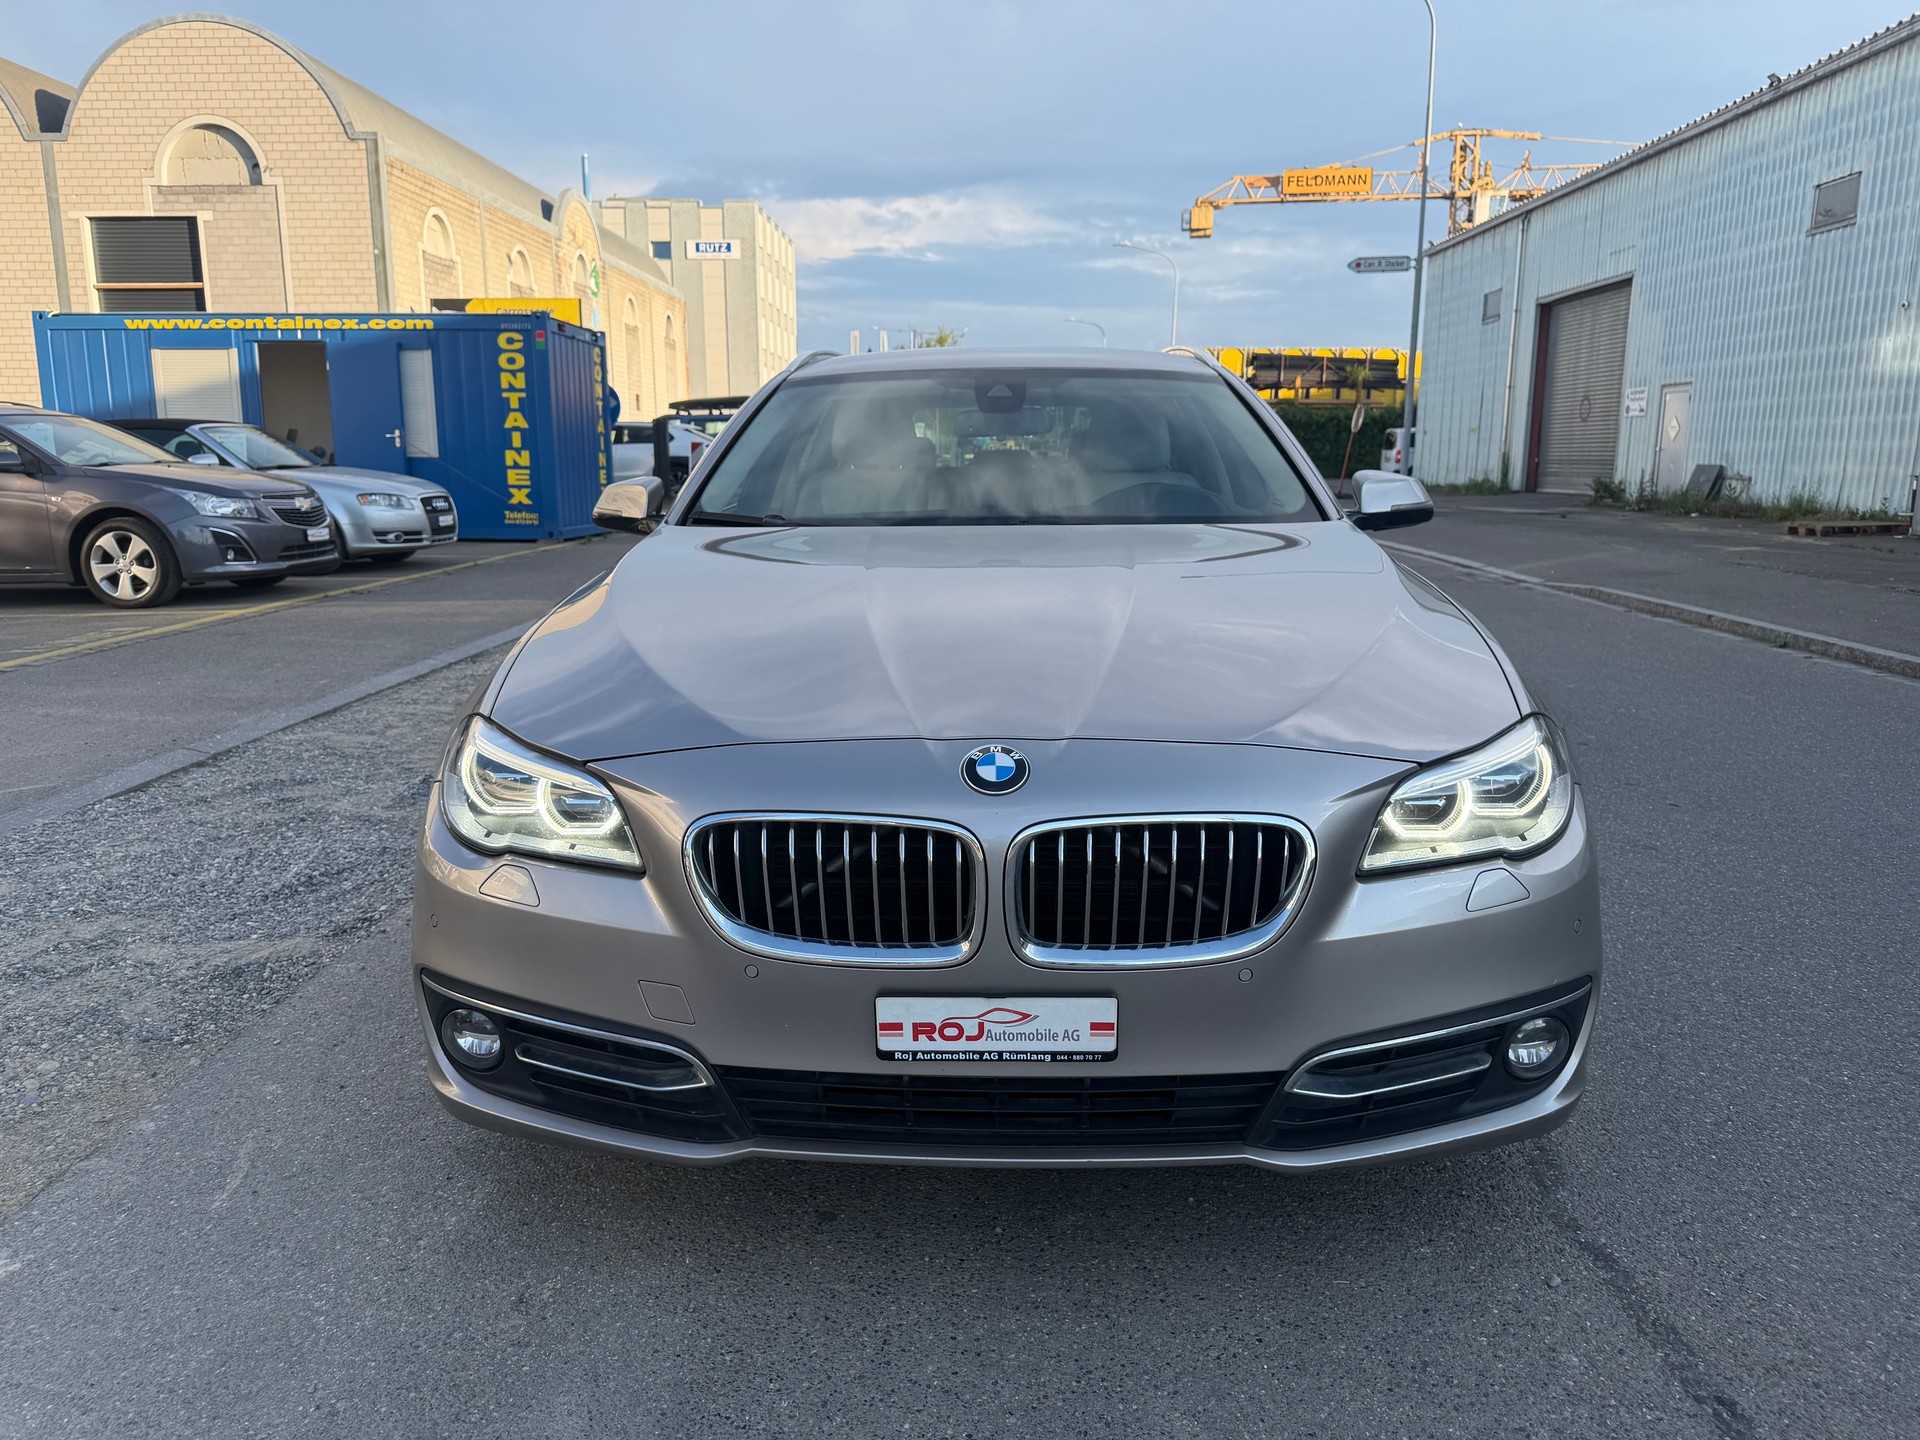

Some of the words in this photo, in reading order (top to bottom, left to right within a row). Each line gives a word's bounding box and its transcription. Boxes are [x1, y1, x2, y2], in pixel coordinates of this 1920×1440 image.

[1287, 174, 1367, 187] FELDMANN
[699, 243, 728, 252] RUTZ
[124, 316, 434, 329] www.containex.com
[497, 332, 533, 504] CONTAINEX
[971, 746, 1022, 760] BMW
[912, 1022, 984, 1042] ROJ
[985, 1028, 1059, 1042] Automobile
[1062, 1029, 1080, 1042] AG
[894, 1052, 912, 1061] Roj
[917, 1052, 980, 1060] Automobile
[983, 1052, 998, 1060] AG
[1003, 1051, 1052, 1062] Rümlang
